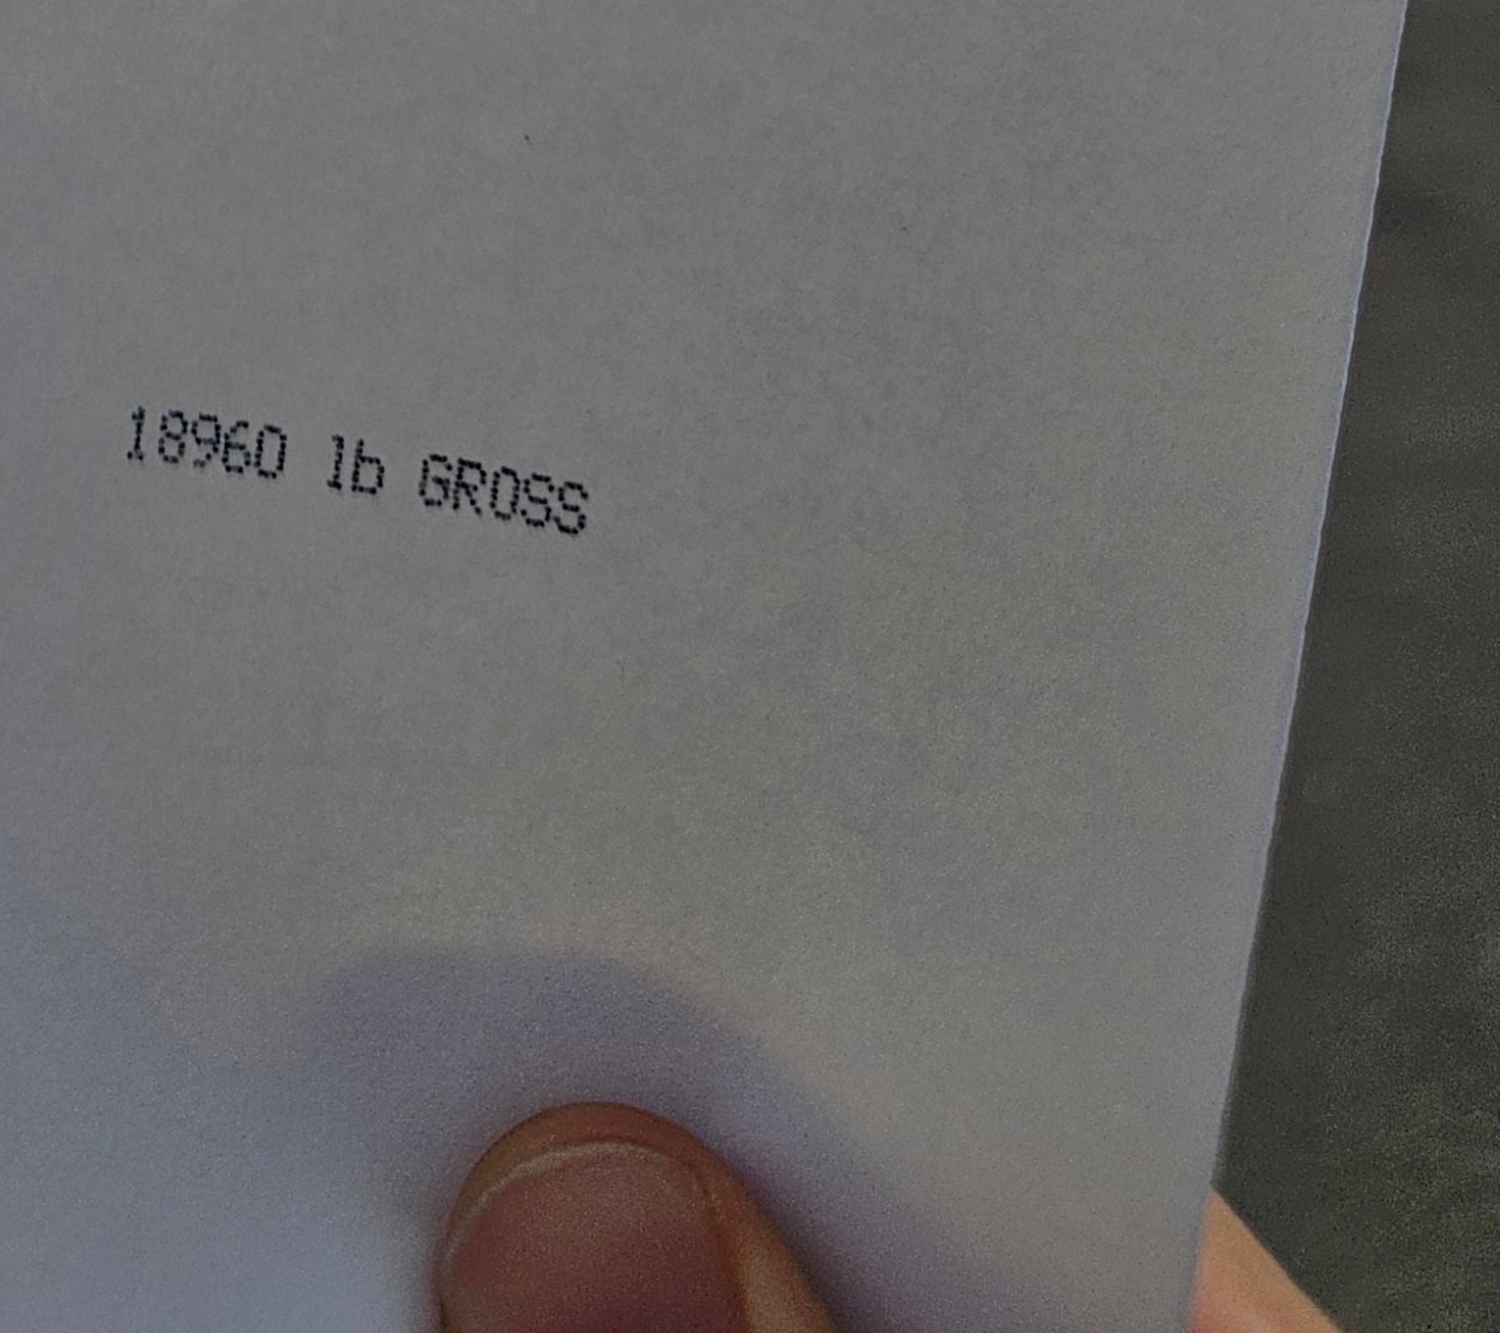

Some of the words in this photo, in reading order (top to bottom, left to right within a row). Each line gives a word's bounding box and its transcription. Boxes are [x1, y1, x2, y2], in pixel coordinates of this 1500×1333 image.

[126, 405, 288, 480] 18960
[326, 434, 387, 496] lb
[418, 453, 590, 538] GROSS
